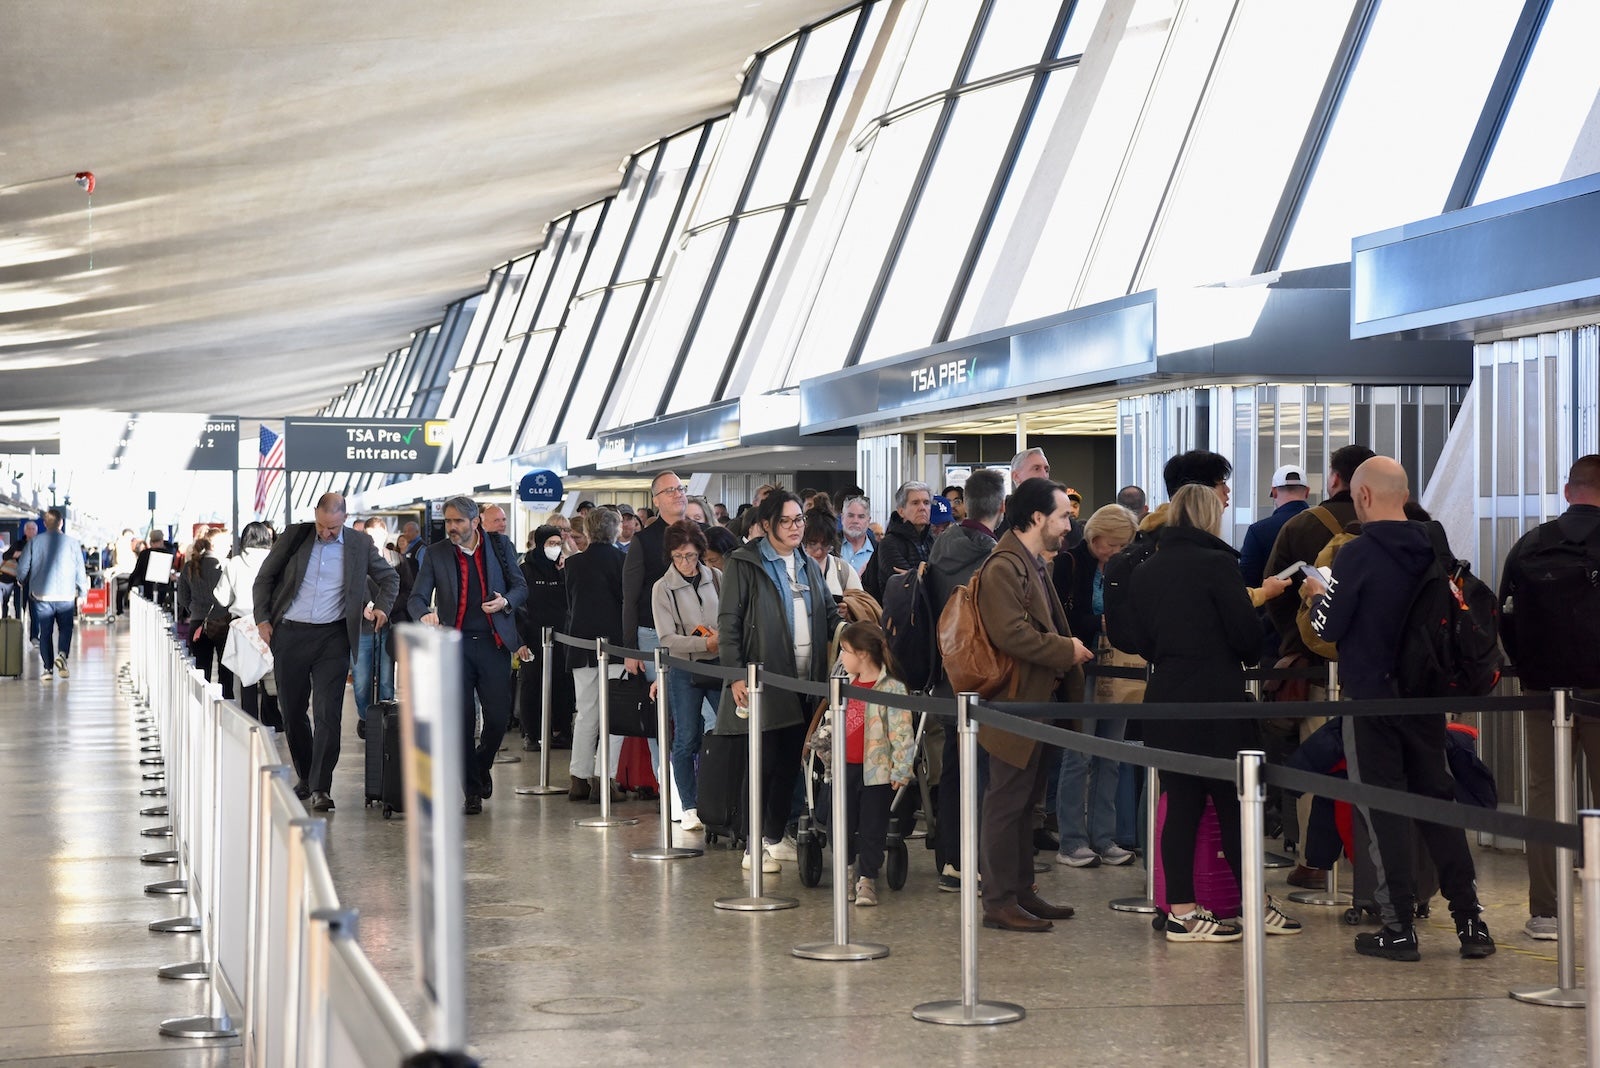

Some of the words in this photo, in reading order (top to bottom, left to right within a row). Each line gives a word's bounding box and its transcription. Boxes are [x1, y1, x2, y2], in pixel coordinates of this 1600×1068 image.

[911, 366, 936, 392] TSA
[939, 359, 967, 387] PRE
[346, 429, 375, 443] TSA
[378, 429, 401, 443] Pre
[346, 447, 418, 460] Entrance
[938, 502, 947, 512] LA
